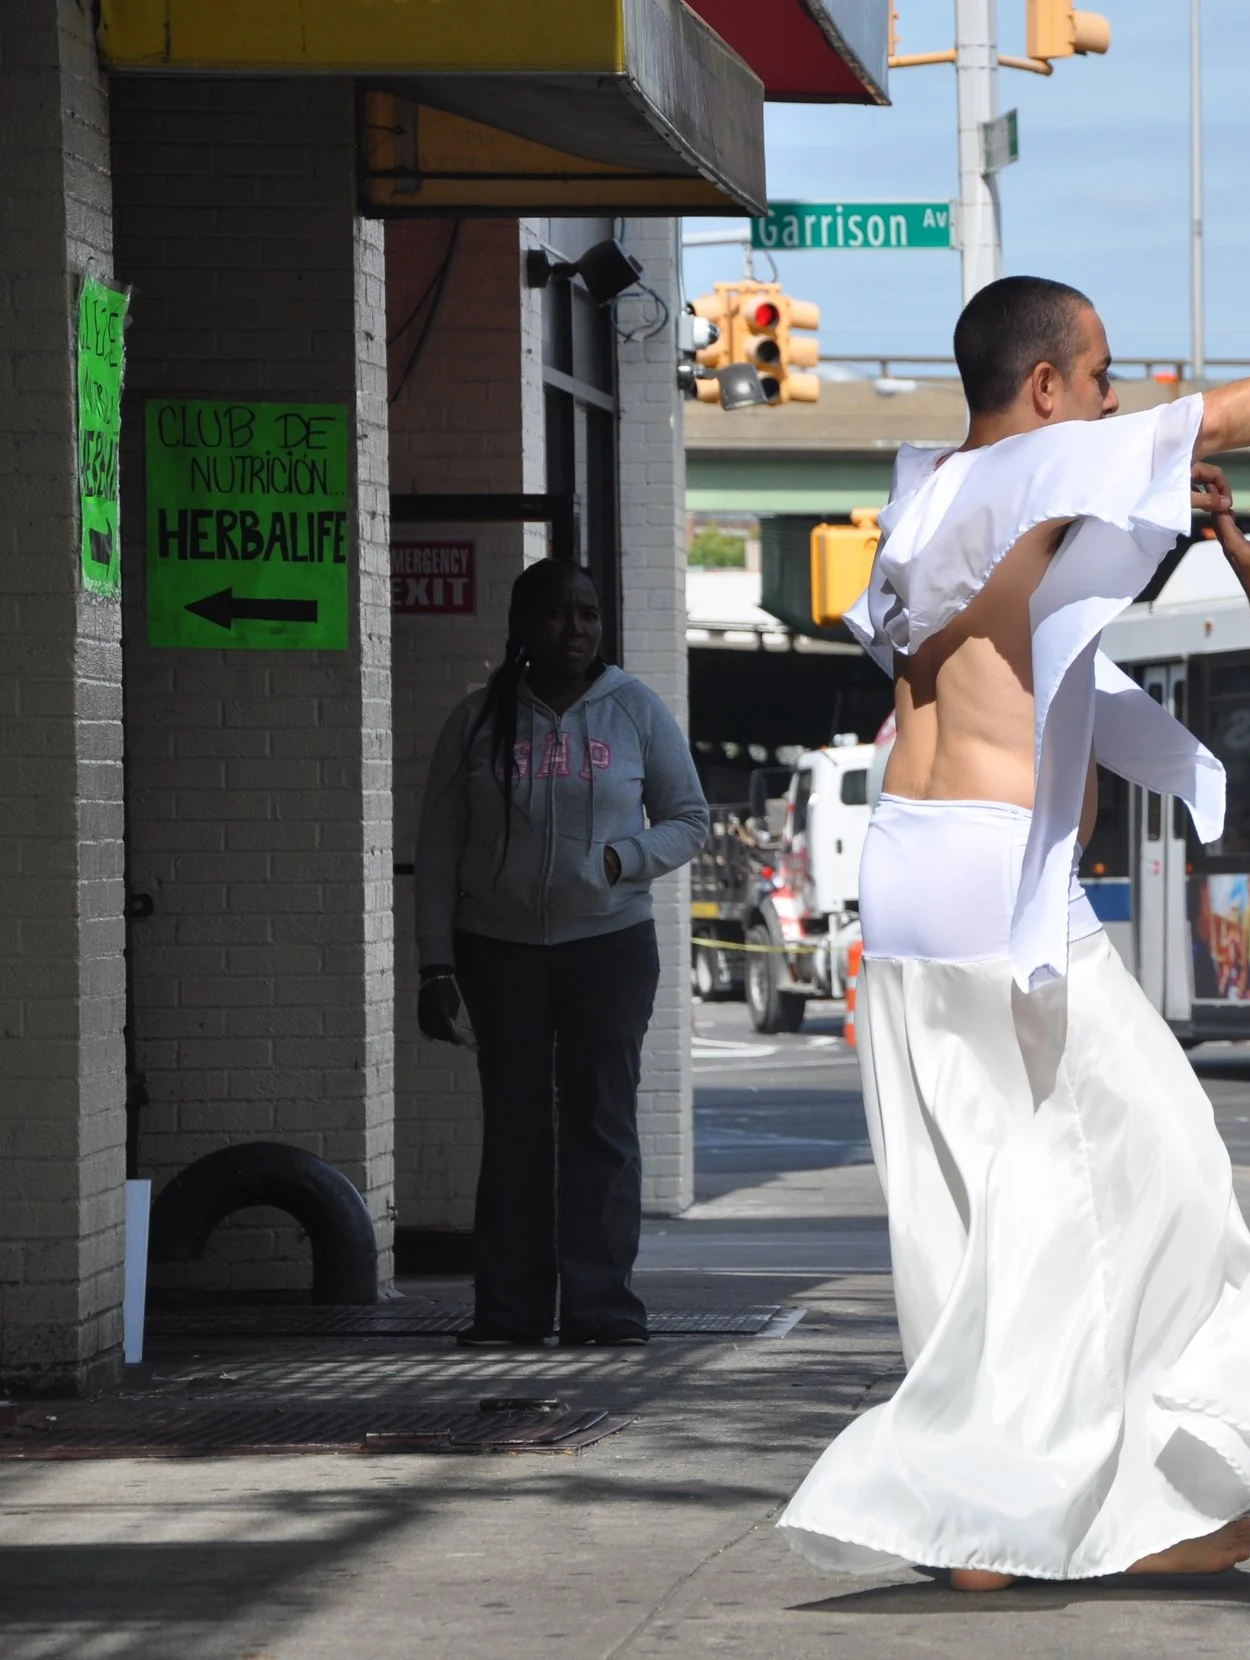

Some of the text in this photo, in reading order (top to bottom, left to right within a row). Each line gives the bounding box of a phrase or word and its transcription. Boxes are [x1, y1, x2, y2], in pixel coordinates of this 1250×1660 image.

[758, 205, 908, 247] Garrison
[157, 404, 337, 450] CLUB DE
[157, 508, 347, 564] HERBALIFE
[391, 547, 469, 574] MERGENCY
